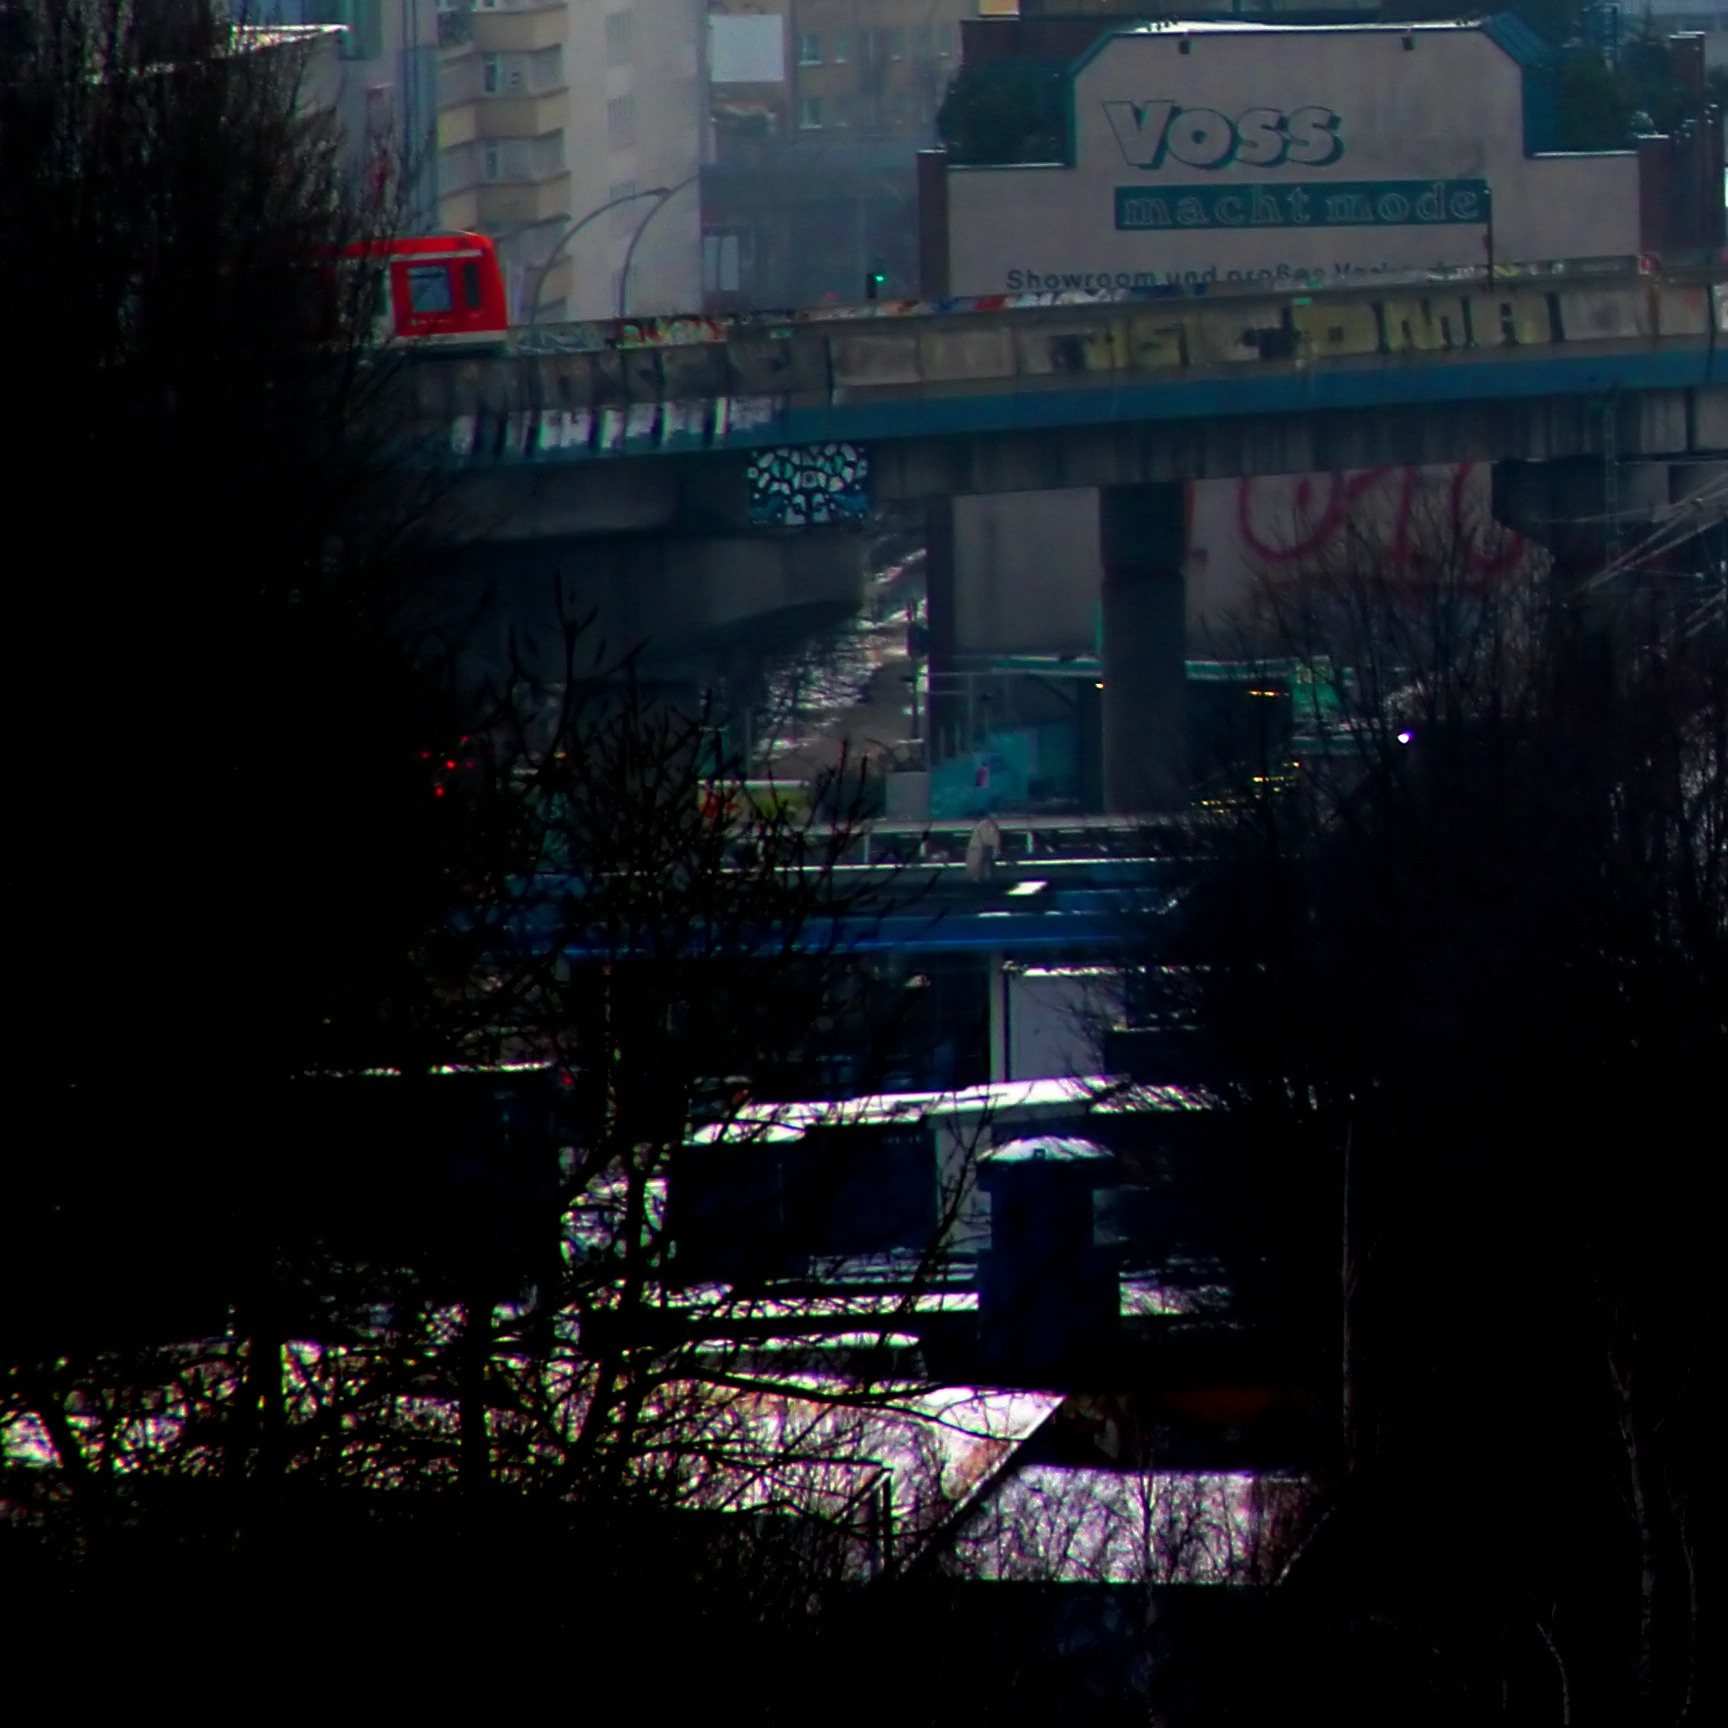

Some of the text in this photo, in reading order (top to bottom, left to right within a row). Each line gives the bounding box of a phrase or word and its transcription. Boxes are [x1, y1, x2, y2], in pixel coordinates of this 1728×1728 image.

[1124, 180, 1481, 226] macht mode
[1006, 269, 1155, 290] Showroom
